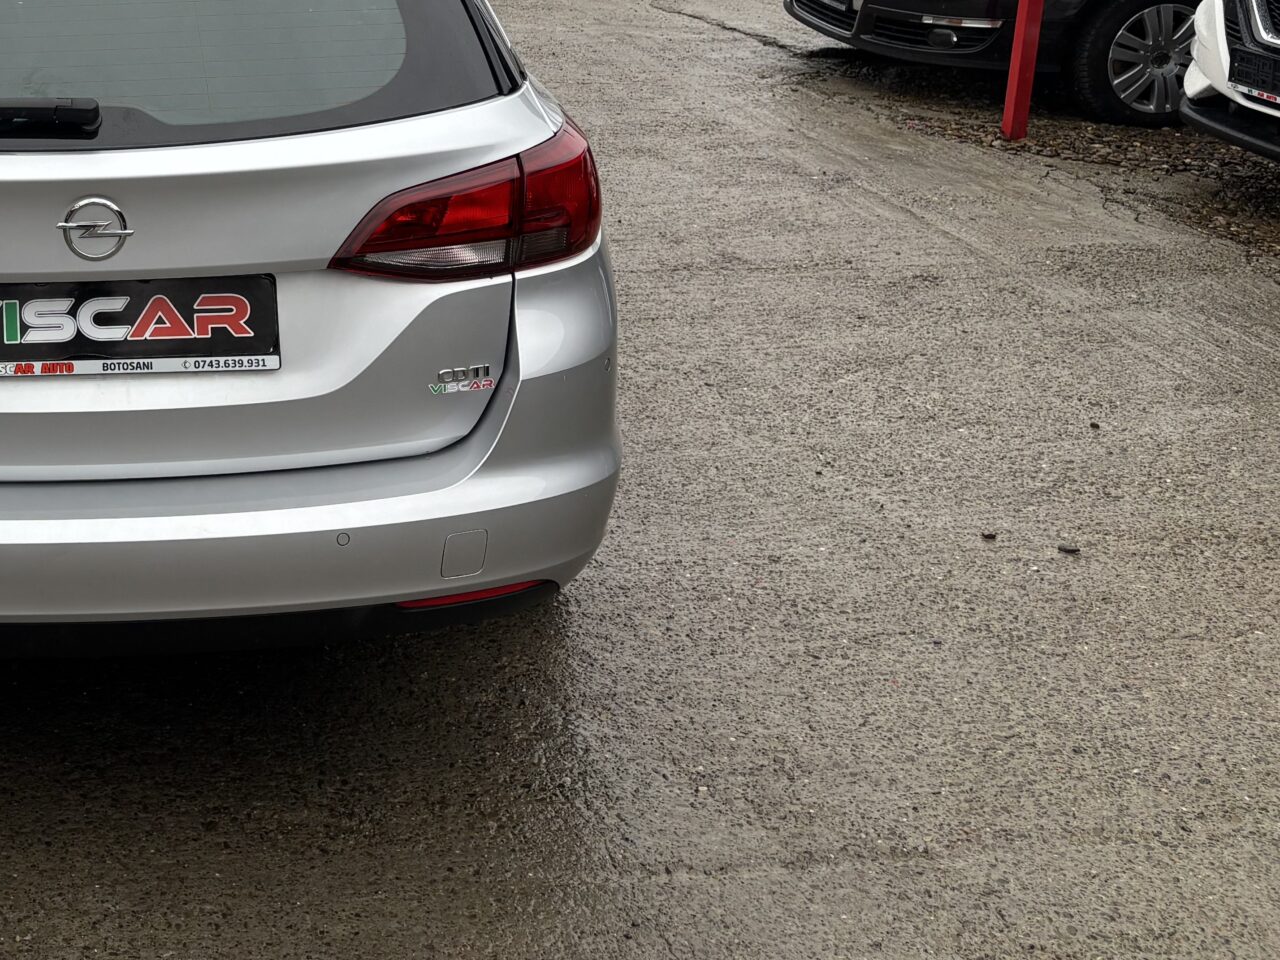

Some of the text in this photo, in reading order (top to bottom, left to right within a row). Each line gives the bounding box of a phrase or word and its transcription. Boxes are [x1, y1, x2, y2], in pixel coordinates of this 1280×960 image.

[40, 362, 74, 375] AUTO
[102, 361, 153, 371] BOTOSANI
[193, 358, 267, 370] 0743.639.931
[438, 364, 490, 383] CDTI
[428, 378, 495, 394] VISCAR
